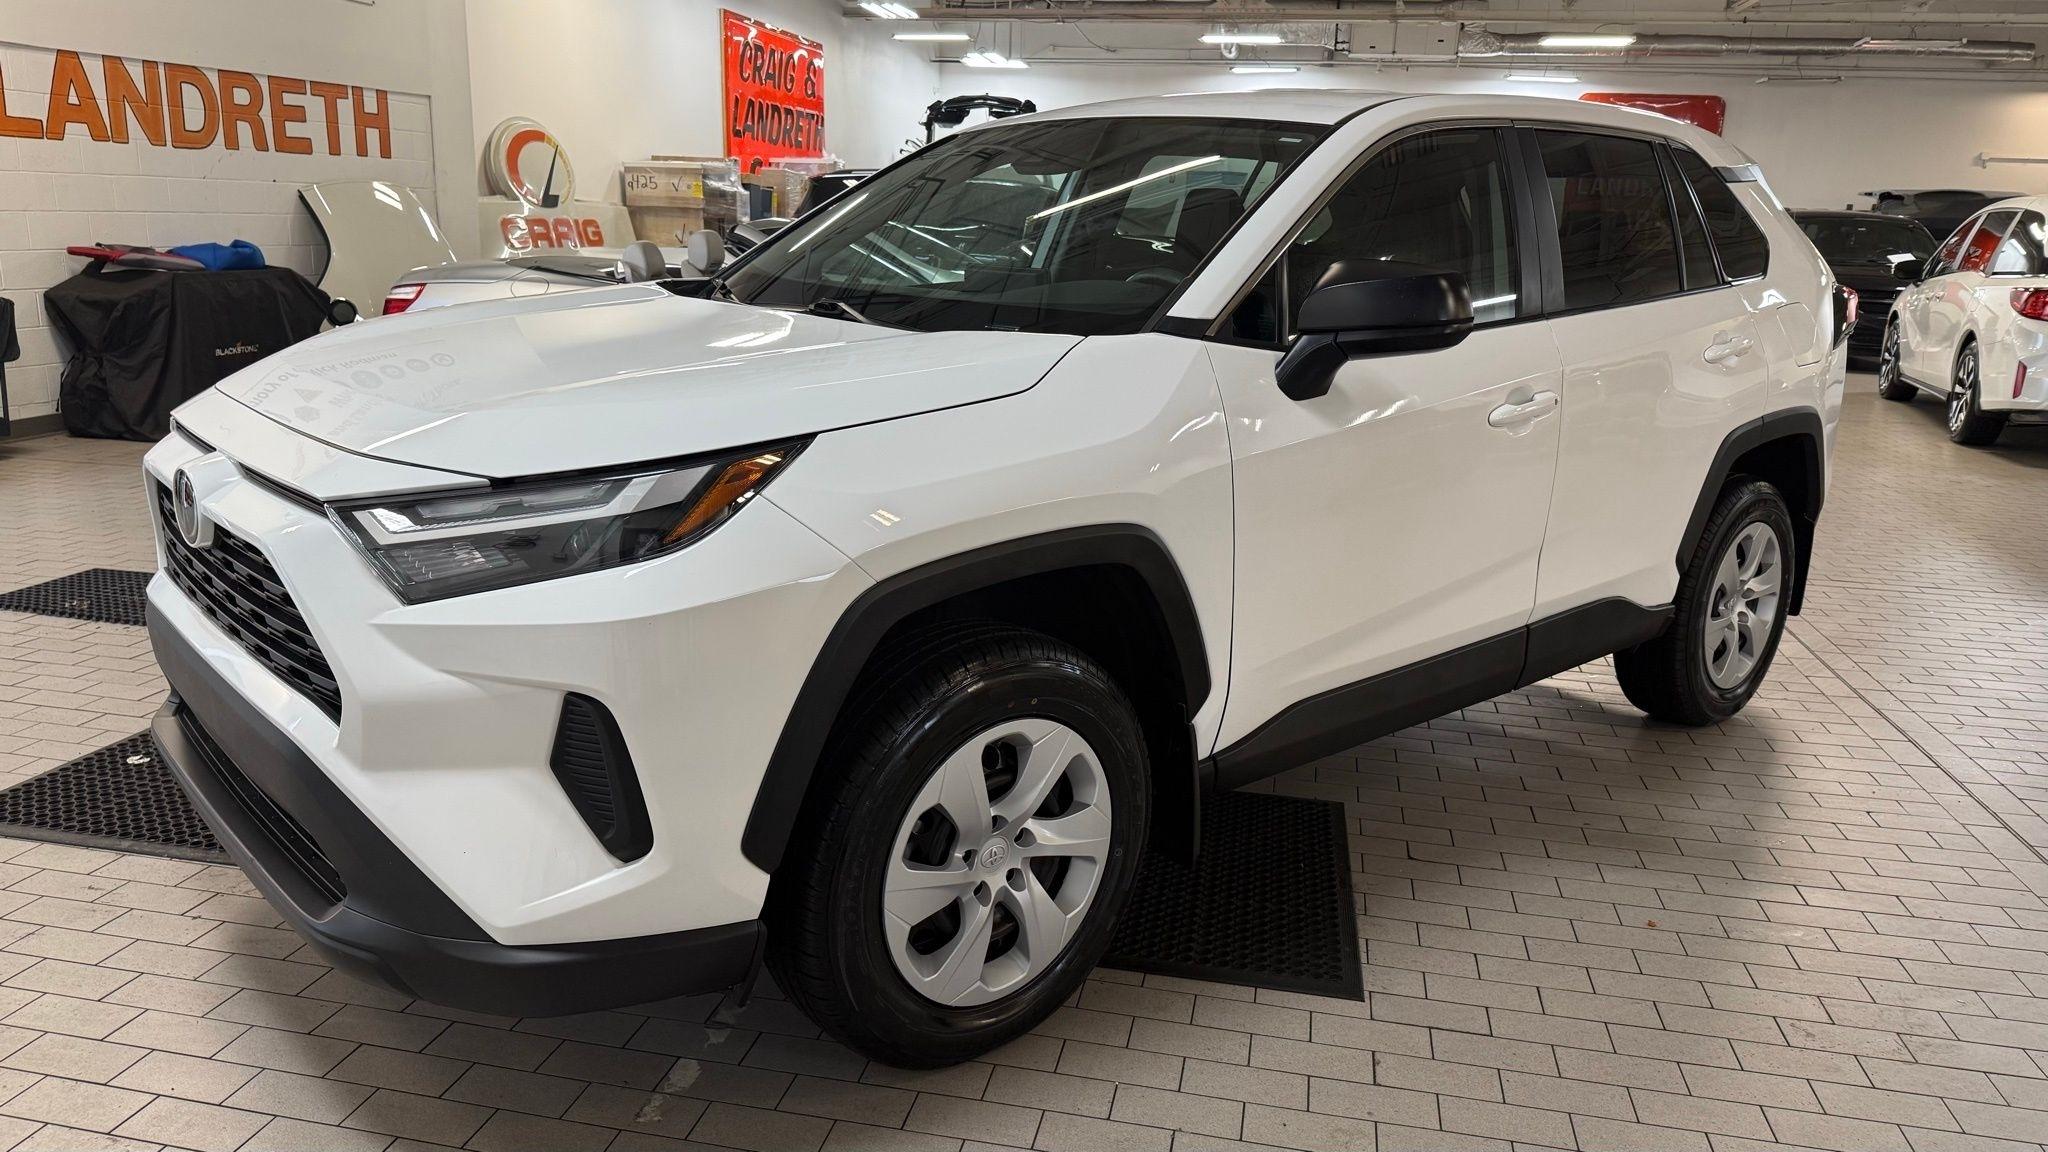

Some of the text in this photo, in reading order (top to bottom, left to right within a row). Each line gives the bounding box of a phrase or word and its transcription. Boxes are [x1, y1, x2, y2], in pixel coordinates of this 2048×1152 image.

[739, 40, 817, 99] CRAIG &
[0, 49, 393, 159] LANDRETH
[732, 95, 825, 153] LANDRETH
[500, 216, 605, 250] CRAIG
